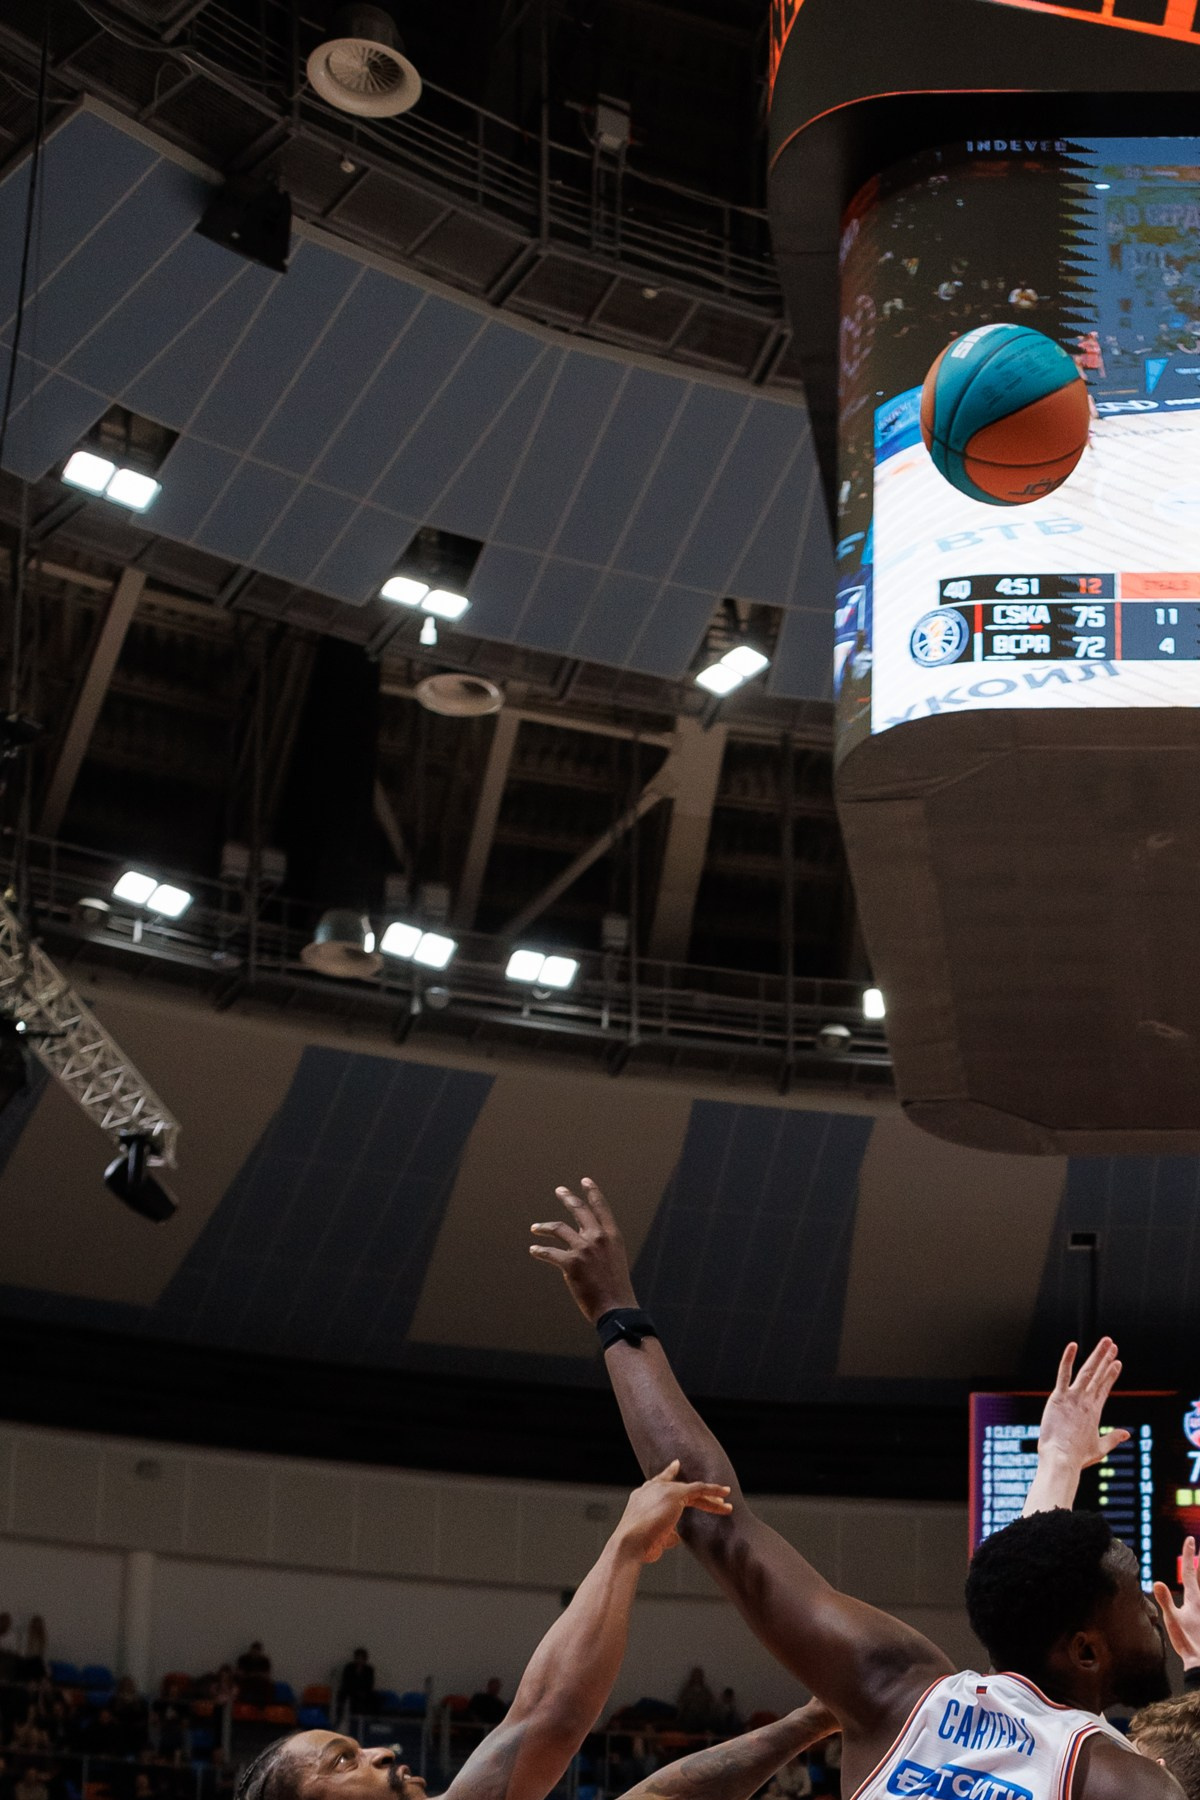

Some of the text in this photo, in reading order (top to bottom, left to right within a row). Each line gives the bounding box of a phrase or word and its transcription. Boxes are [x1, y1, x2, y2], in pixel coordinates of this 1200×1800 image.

[1078, 578, 1101, 595] 12
[992, 604, 1051, 625] CSKA
[1072, 604, 1106, 629] 75
[1155, 607, 1179, 626] 11
[1072, 636, 1106, 660] 72
[1158, 637, 1175, 655] 4
